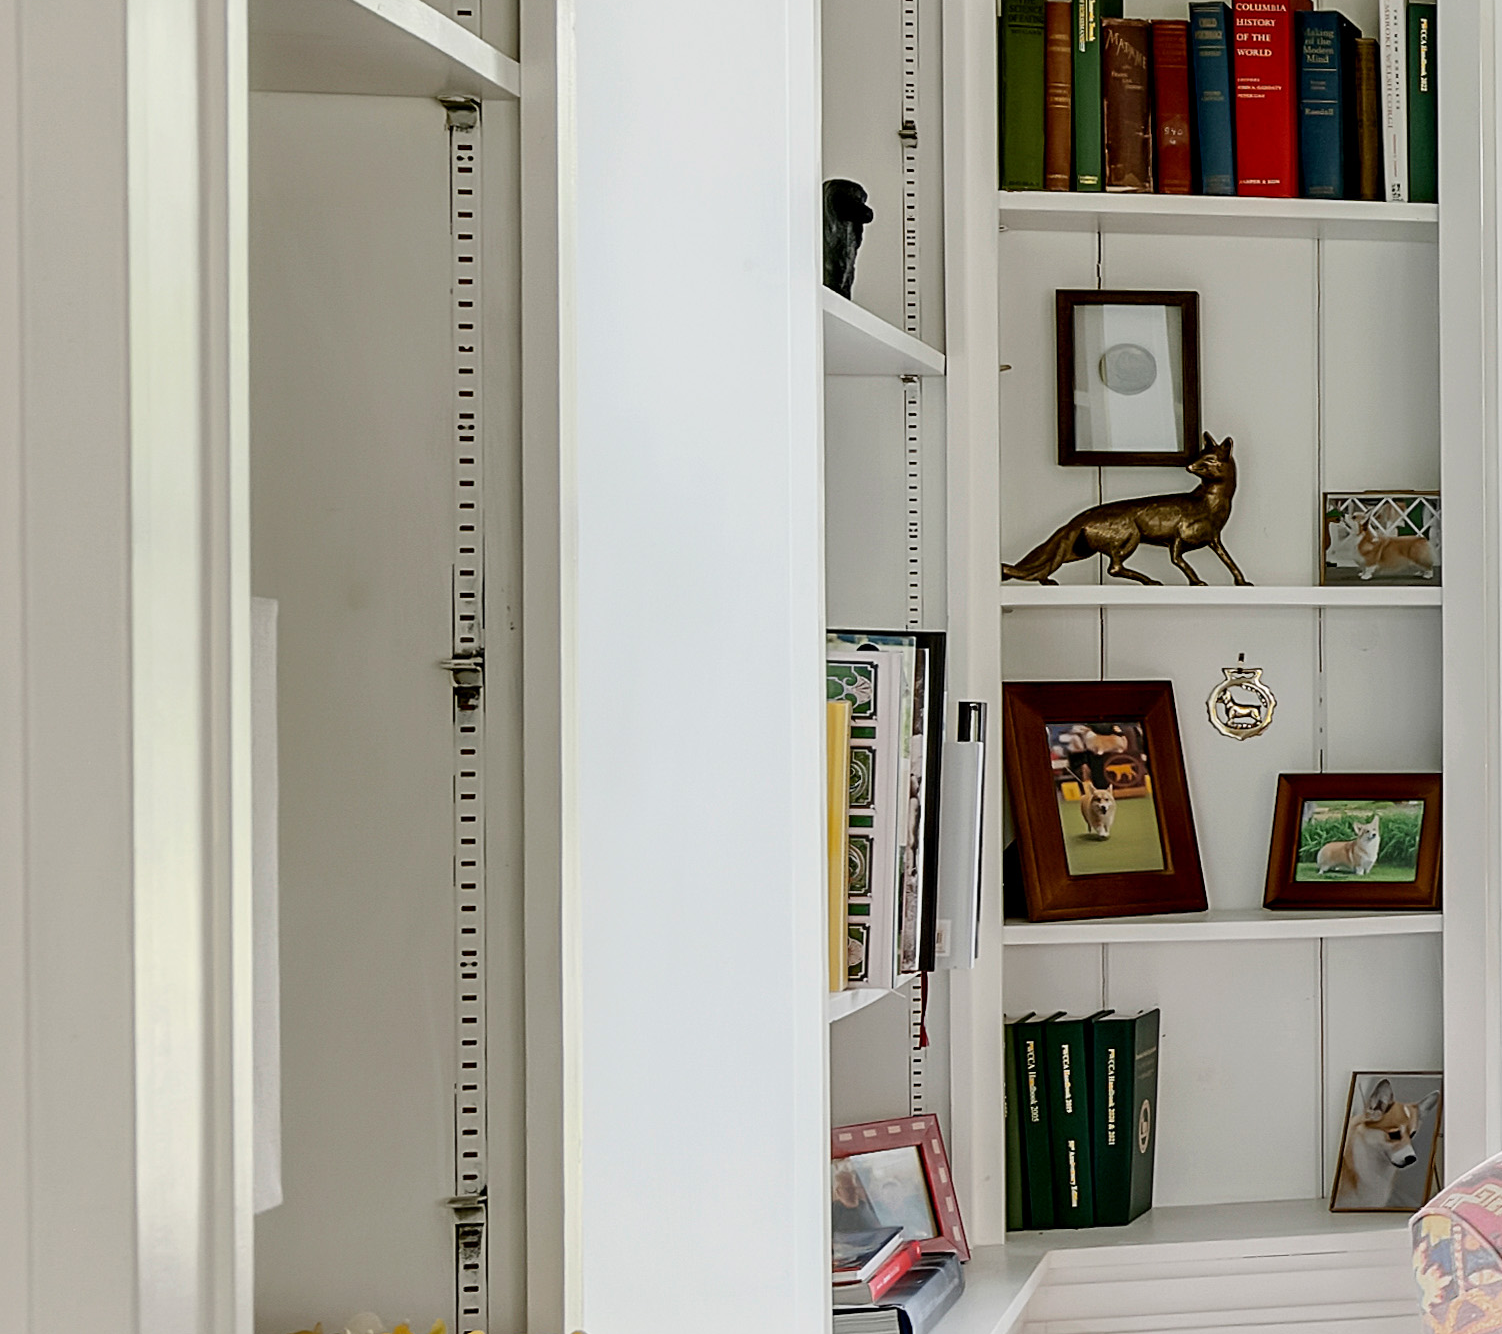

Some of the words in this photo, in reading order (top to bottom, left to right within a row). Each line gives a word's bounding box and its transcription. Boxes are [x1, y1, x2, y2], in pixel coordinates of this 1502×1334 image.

[1235, 3, 1287, 12] COLUMBIA
[1236, 18, 1276, 27] HISTORY
[1236, 33, 1248, 41] OF
[1251, 33, 1271, 42] THE
[1316, 37, 1332, 45] the
[1236, 49, 1272, 57] WORLD
[1303, 46, 1335, 55] Modern
[1306, 54, 1330, 63] Mind
[1385, 53, 1393, 91] WELSH
[1026, 1040, 1035, 1069] PWCCA
[1107, 1048, 1116, 1075] PWCCA
[1028, 1071, 1038, 1105] Handbook
[1108, 1075, 1116, 1107] Handbook
